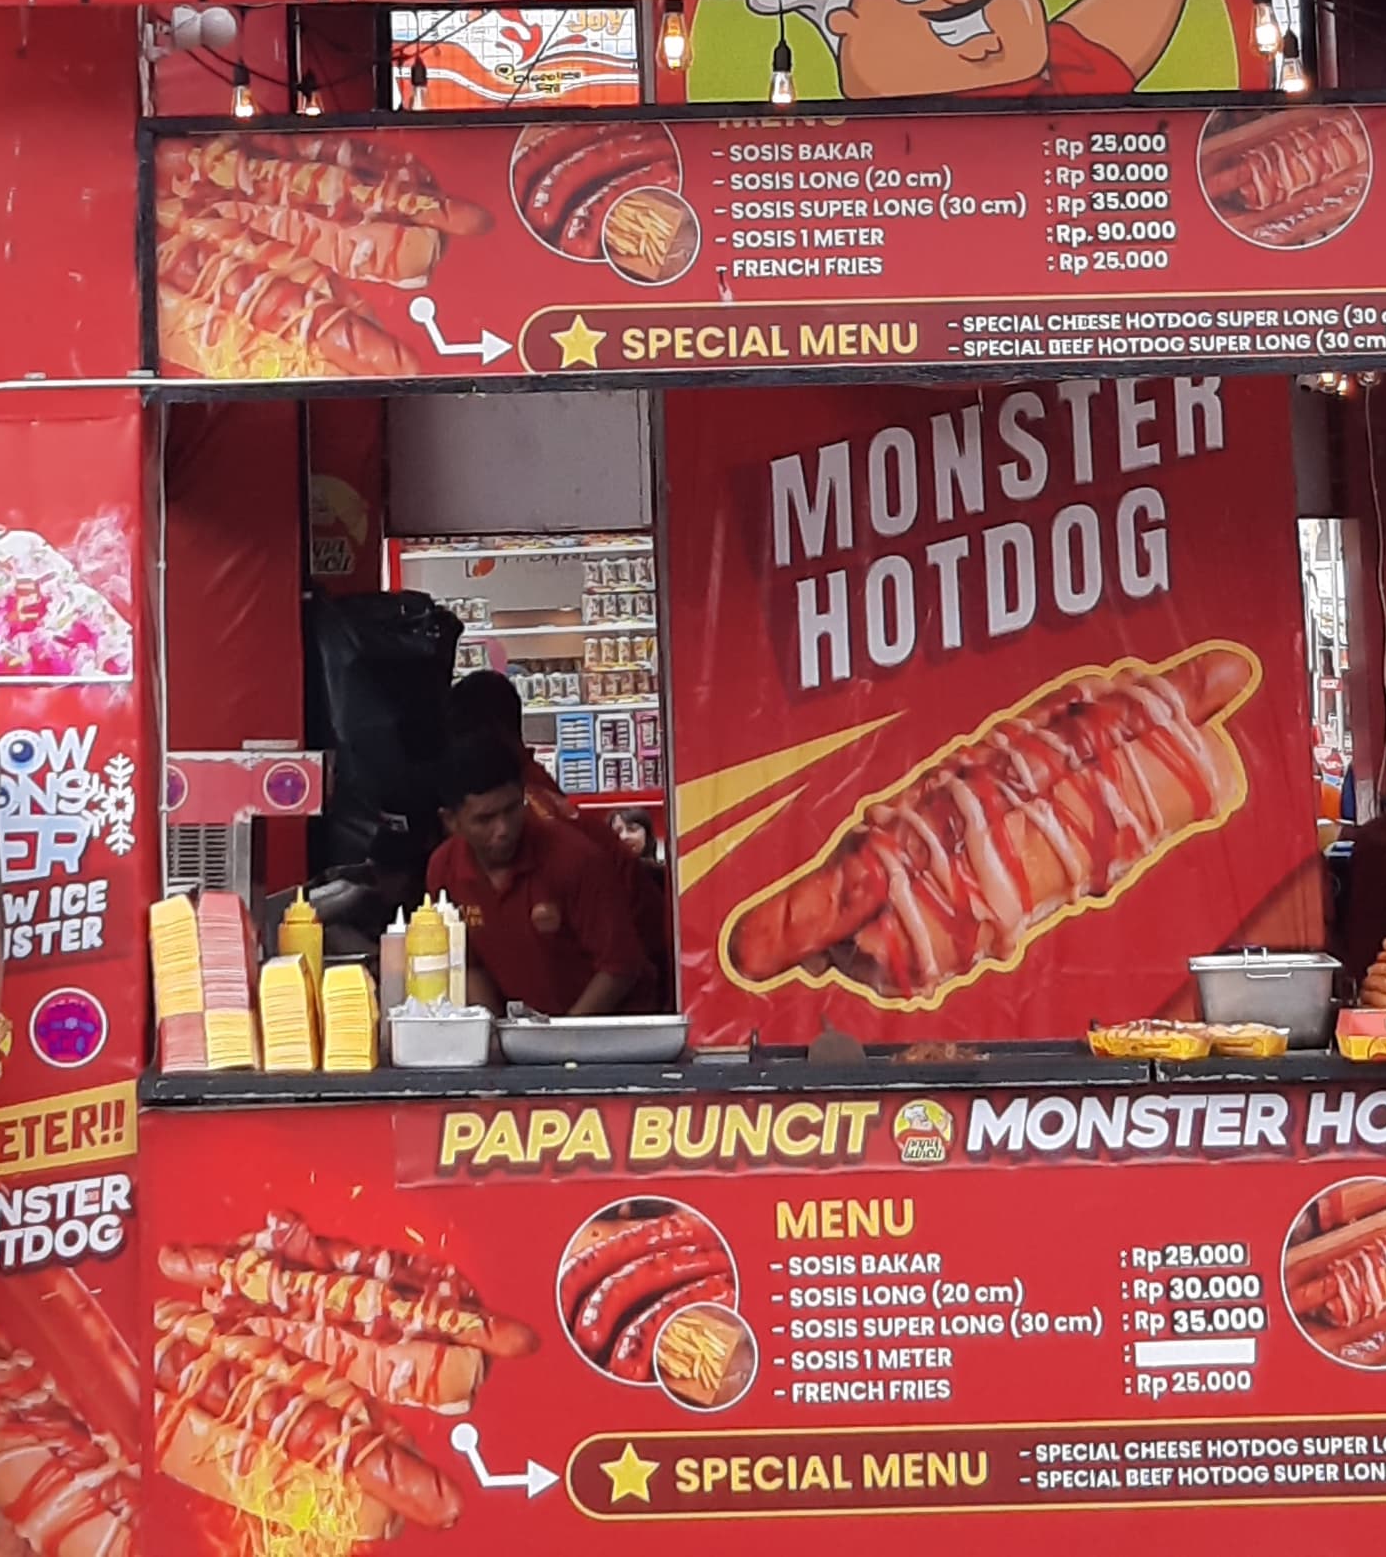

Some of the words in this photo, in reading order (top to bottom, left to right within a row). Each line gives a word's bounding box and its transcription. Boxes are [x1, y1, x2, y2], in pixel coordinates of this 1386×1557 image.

[729, 143, 794, 162] SOSIS
[798, 142, 873, 161] BAKAR
[621, 324, 789, 361] SPECIAL
[800, 322, 918, 356] MENU
[963, 338, 1046, 358] SPECIAL
[1048, 337, 1094, 355] BEEF
[1097, 336, 1186, 356] HOTDOG
[1189, 335, 1252, 353] SUPER
[1255, 333, 1311, 351] LONG
[1316, 328, 1355, 356] (30
[769, 375, 1226, 568] MONSTER
[795, 486, 1171, 690] HOTDOG
[49, 879, 109, 919] ICE
[440, 1108, 612, 1166] PAPA
[629, 1101, 880, 1160] BUNCIT
[966, 1093, 1289, 1152] MONSTER
[776, 1198, 914, 1239] MENU
[788, 1254, 857, 1276] SOSIS
[861, 1253, 942, 1275] BAKAR
[1165, 1243, 1244, 1267] 25.000
[789, 1286, 857, 1308] SOSIS
[862, 1284, 927, 1306] LONG
[932, 1279, 970, 1310] (20
[974, 1277, 1024, 1307] cm)
[1170, 1274, 1260, 1300] 30.000
[790, 1318, 858, 1339] SOSIS
[862, 1316, 935, 1338] SUPER
[940, 1314, 1005, 1336] LONG
[1010, 1308, 1049, 1339] (30
[1054, 1306, 1103, 1337] cm)
[1173, 1306, 1265, 1333] 35.000
[791, 1349, 859, 1371] SOSIS
[863, 1348, 872, 1370] 1
[877, 1347, 953, 1370] METER
[792, 1380, 885, 1403] FRENCH
[889, 1379, 951, 1401] FRIES
[1171, 1370, 1251, 1392] 25.000
[675, 1454, 853, 1493] SPECIAL
[863, 1451, 988, 1489] MENU
